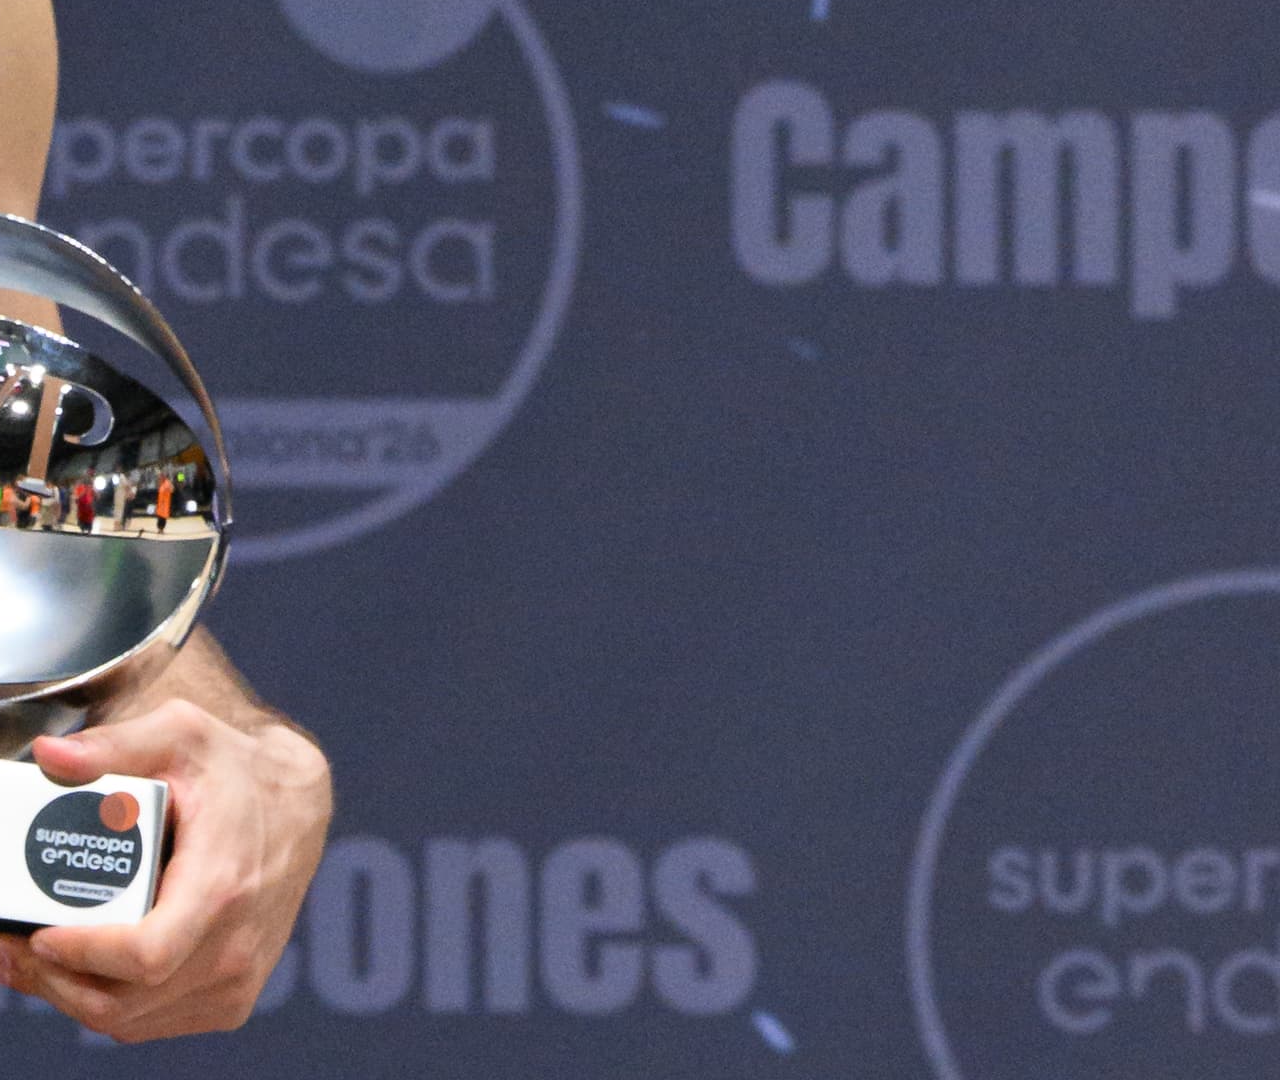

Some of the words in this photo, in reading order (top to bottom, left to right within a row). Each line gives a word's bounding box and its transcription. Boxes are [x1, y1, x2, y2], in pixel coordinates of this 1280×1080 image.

[48, 118, 496, 198] percopa
[78, 194, 496, 304] ndesa
[35, 827, 135, 855] supercopa
[41, 846, 132, 875] endesa
